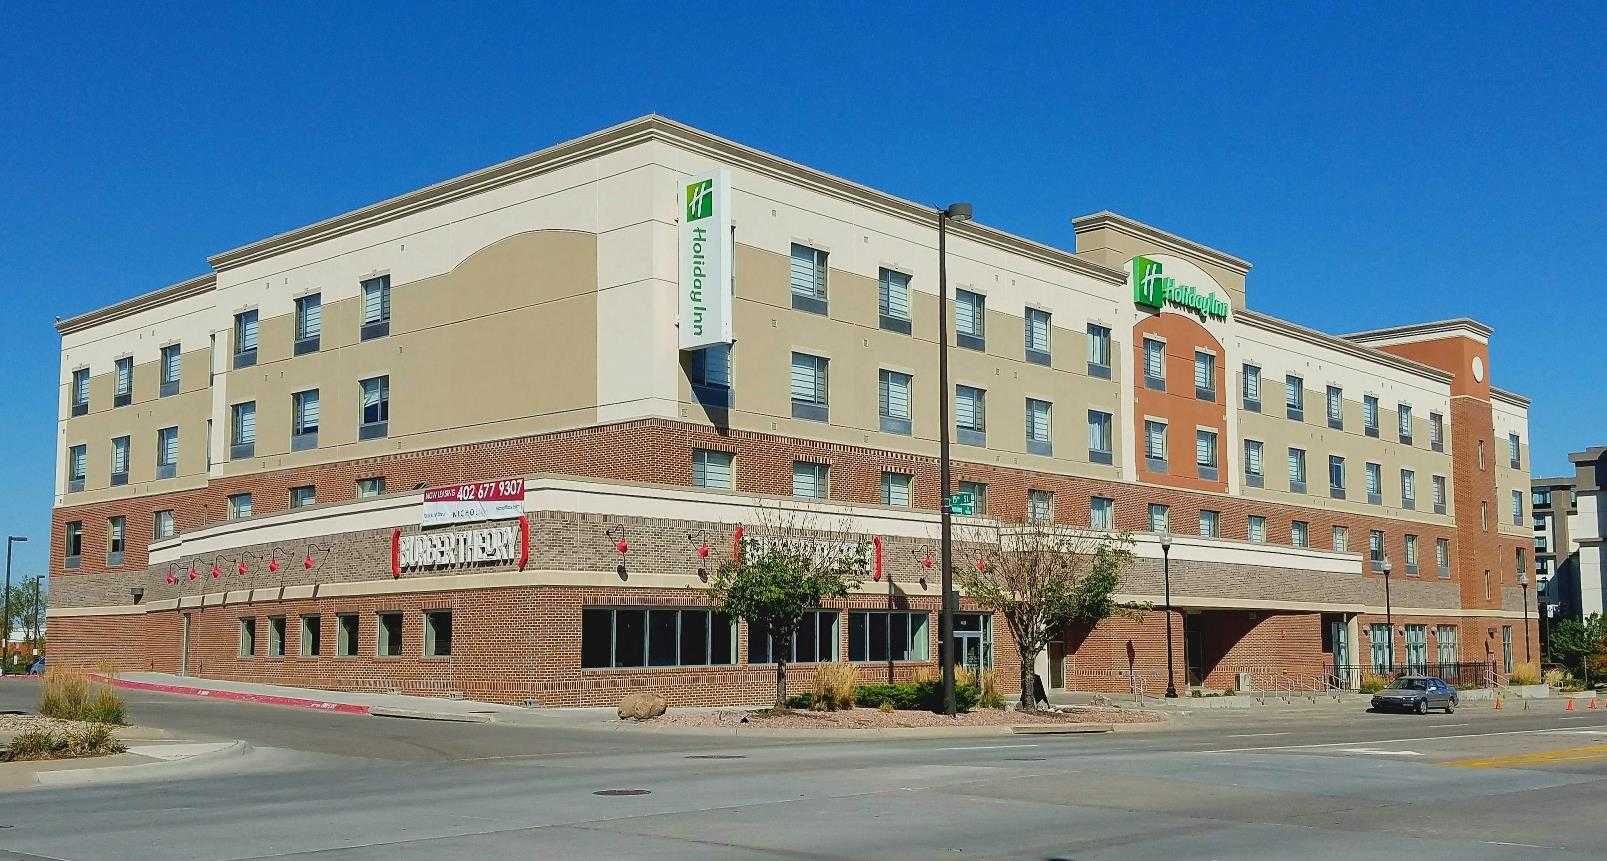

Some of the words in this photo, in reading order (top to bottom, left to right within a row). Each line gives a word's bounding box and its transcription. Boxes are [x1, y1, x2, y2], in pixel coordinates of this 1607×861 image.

[690, 226, 707, 303] Holiday
[1163, 277, 1208, 316] Holiday
[1207, 291, 1228, 317] Inn
[693, 306, 707, 336] Inn
[425, 490, 437, 500] NOW
[437, 488, 456, 499] LEASING
[457, 484, 475, 501] 402
[477, 482, 496, 499] 677
[499, 479, 523, 497] 9307
[400, 532, 456, 567] BURGER
[456, 526, 519, 564] THEORY
